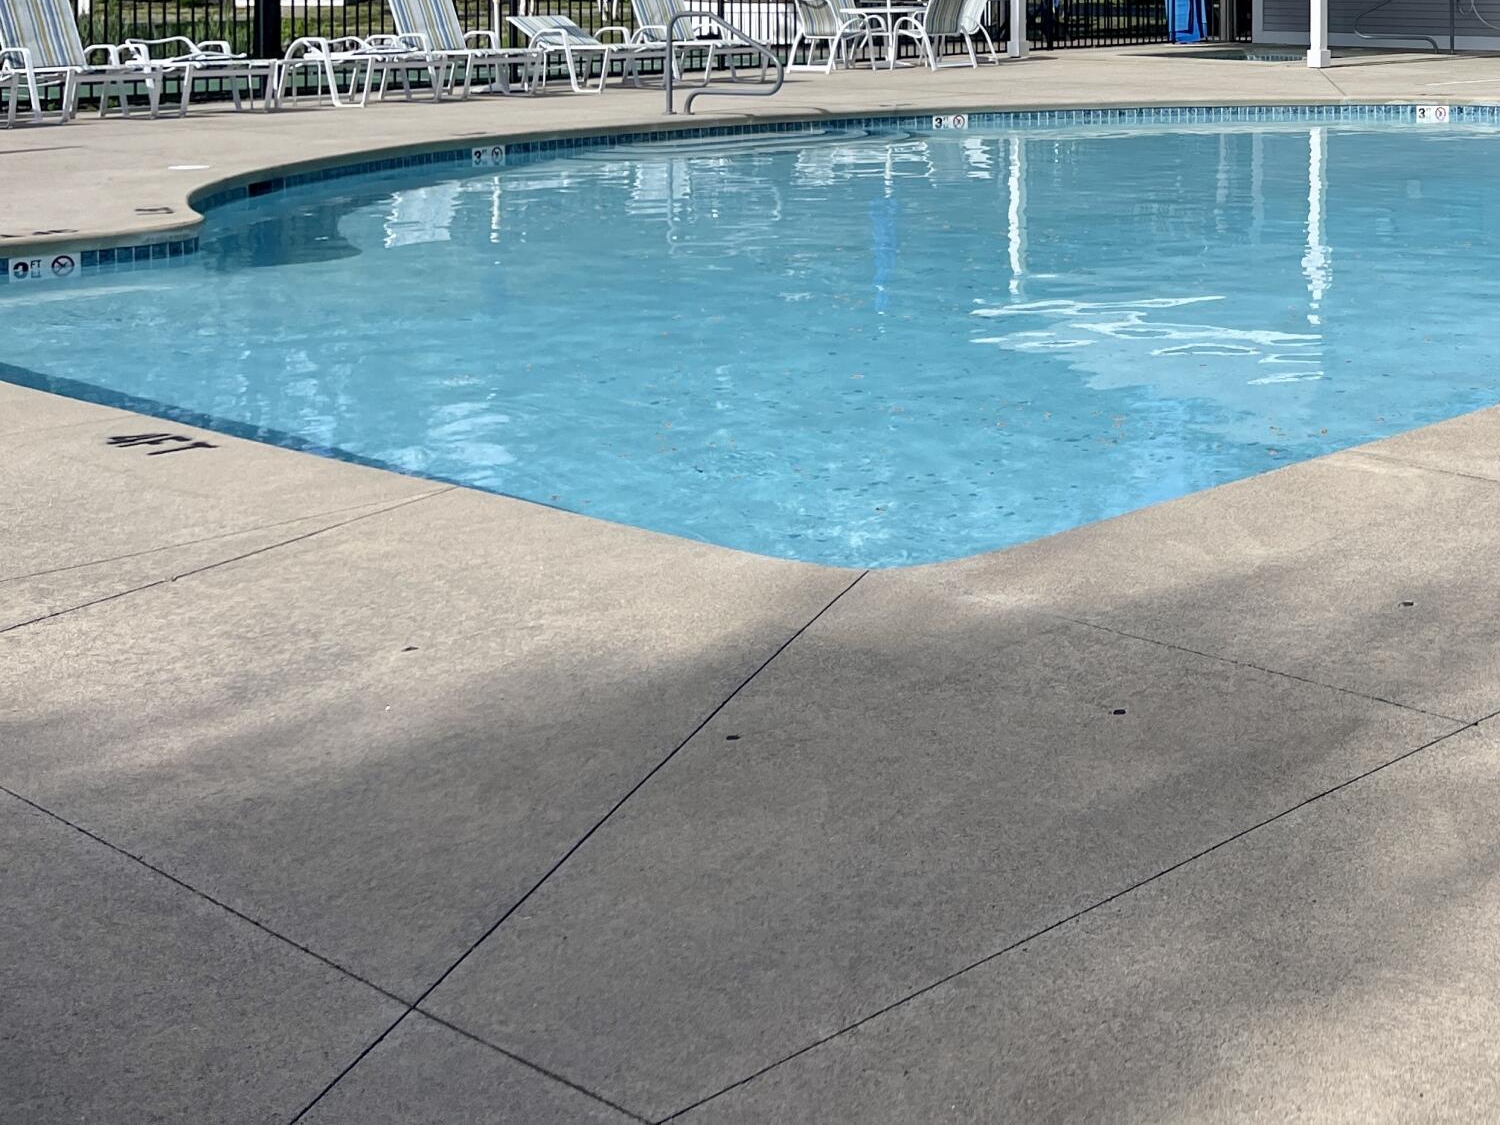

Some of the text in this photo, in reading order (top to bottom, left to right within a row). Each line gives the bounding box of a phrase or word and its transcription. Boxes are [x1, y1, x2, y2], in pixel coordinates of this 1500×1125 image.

[1418, 107, 1426, 119] 3
[935, 117, 943, 129] 3
[31, 260, 41, 269] FT
